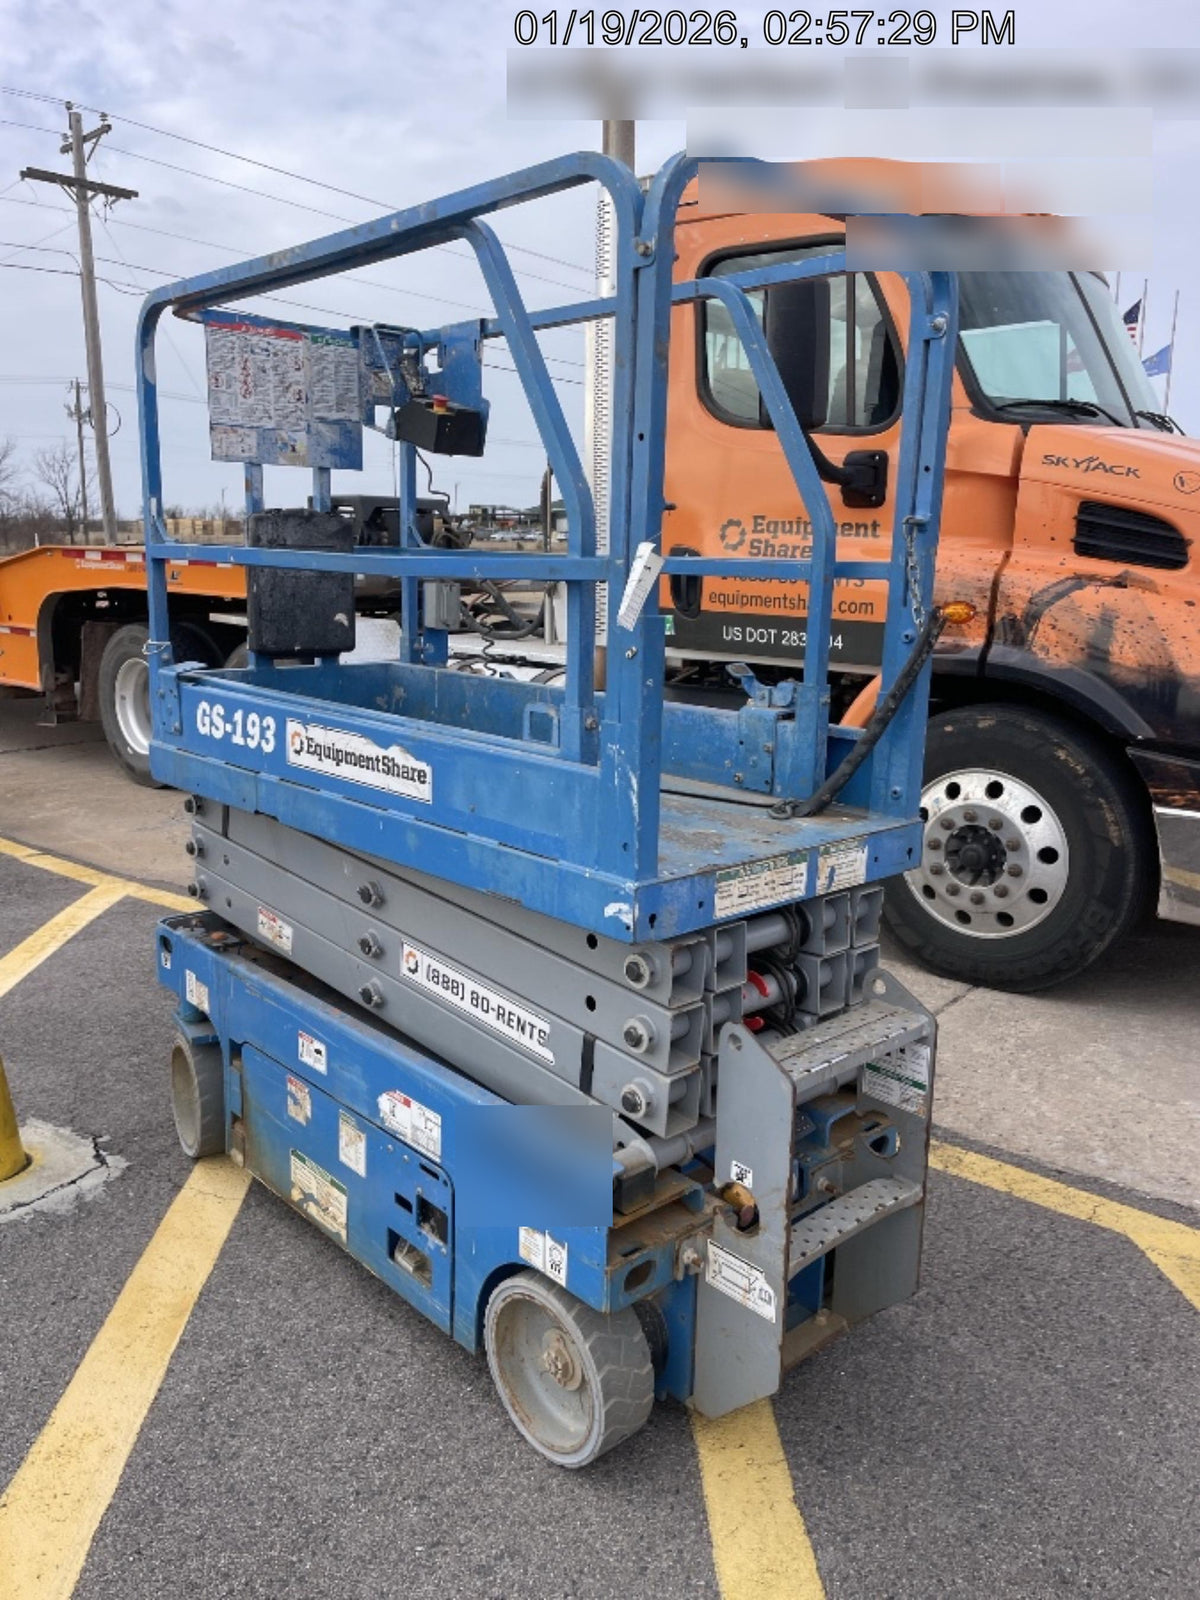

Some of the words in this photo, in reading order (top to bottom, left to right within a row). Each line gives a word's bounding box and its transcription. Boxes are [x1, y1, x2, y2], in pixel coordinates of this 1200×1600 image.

[1042, 454, 1141, 479] SKYJACK
[752, 515, 881, 540] Equipent
[748, 538, 813, 559] Share
[709, 589, 875, 616] equipmentsh.com
[722, 625, 743, 641] US
[746, 627, 777, 644] DOT
[195, 700, 277, 754] GS-193
[305, 736, 428, 785] EquipmentShare
[425, 962, 466, 1001] (888)
[470, 990, 549, 1048] 80-RENTS
